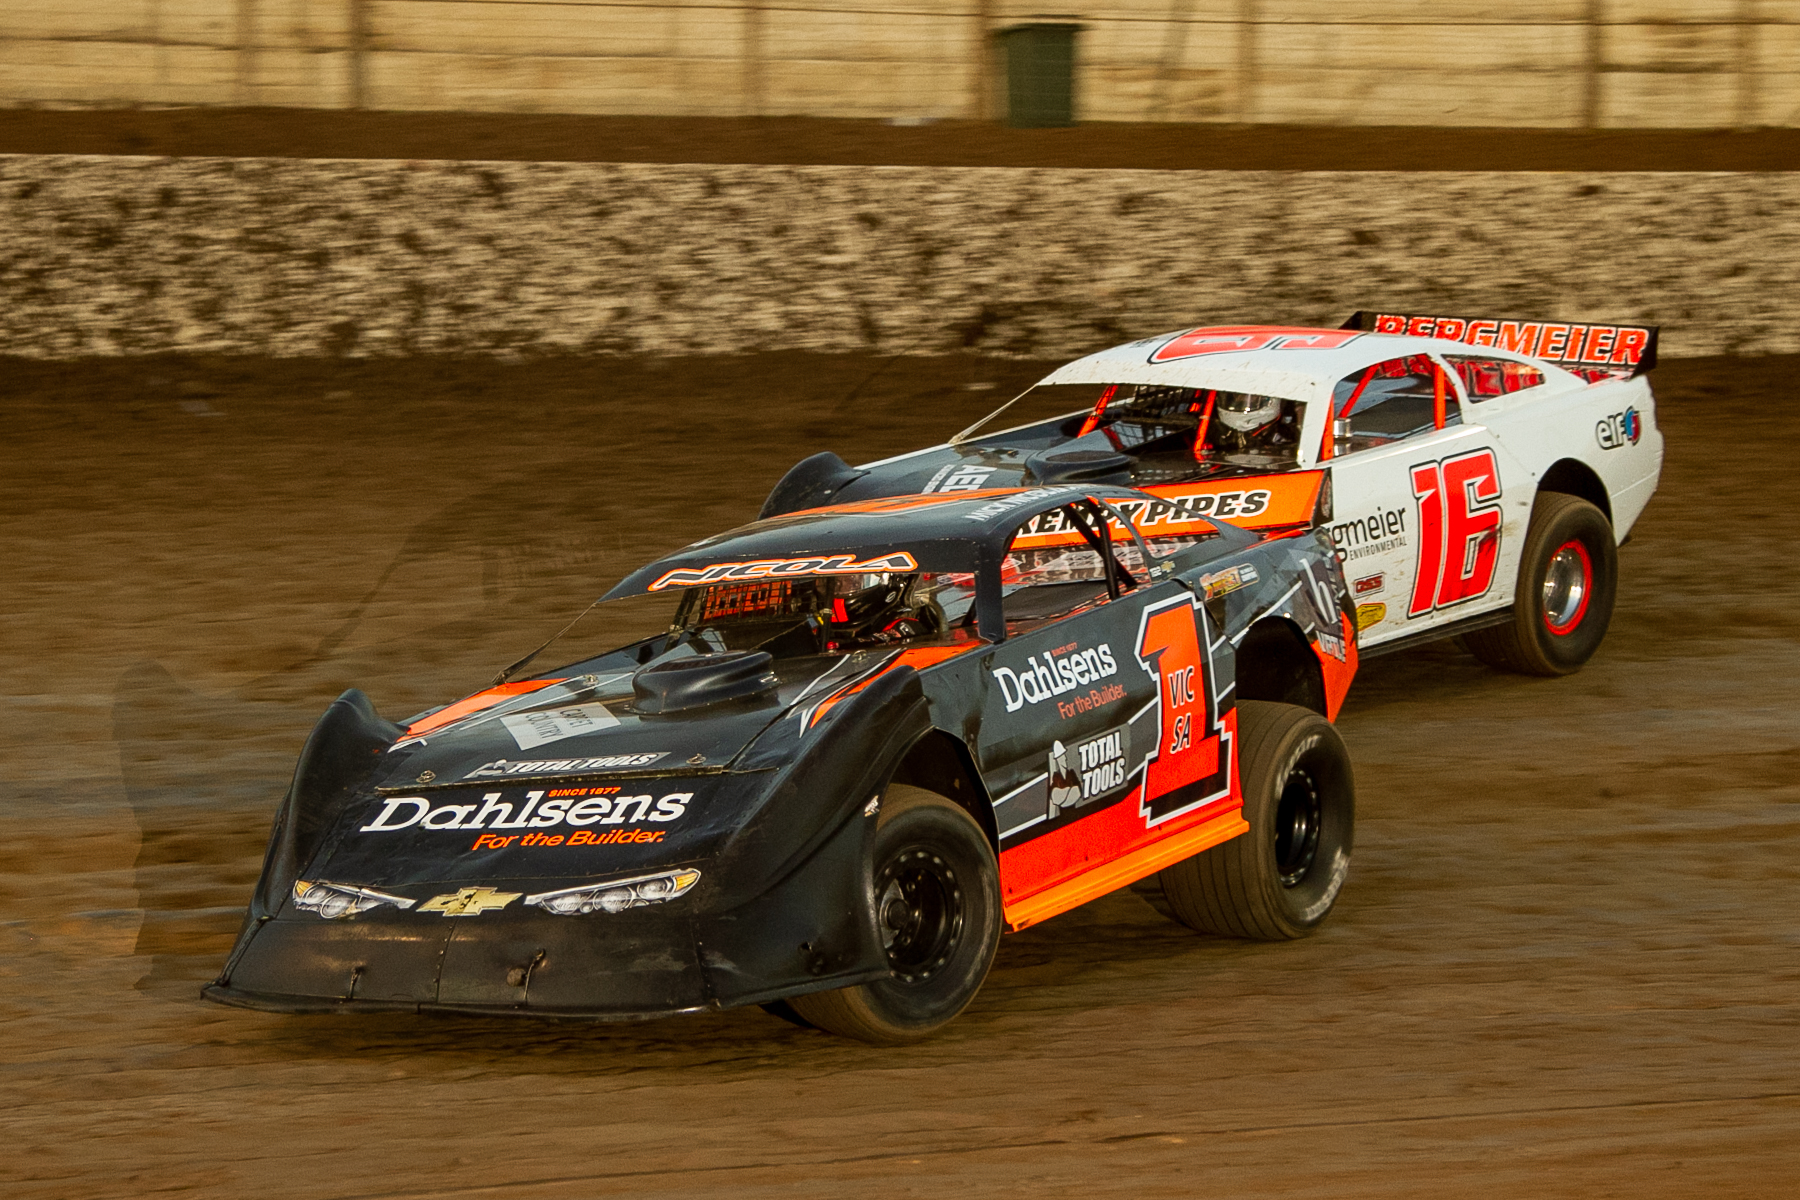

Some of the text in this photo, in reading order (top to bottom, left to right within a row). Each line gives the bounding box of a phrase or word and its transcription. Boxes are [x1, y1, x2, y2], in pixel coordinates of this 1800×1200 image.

[1375, 314, 1649, 366] BERGMEIER
[1141, 489, 1271, 526] PIPES
[1327, 506, 1406, 562] gmeier
[1349, 537, 1407, 561] ENVIRONMENTAL
[1407, 446, 1503, 619] 16
[647, 552, 918, 591] NICOLA
[992, 643, 1117, 713] Dahlsens
[1168, 665, 1195, 709] VIC
[1057, 701, 1076, 720] For
[1074, 695, 1092, 713] the
[1135, 591, 1232, 828] 1
[1078, 731, 1122, 772] TOTAL
[1170, 712, 1192, 755] SA
[507, 753, 658, 774] TOTAL TOOLS
[1082, 757, 1126, 800] TOOLS
[360, 791, 694, 832] Dahlsens
[548, 786, 622, 798] SINCE 1877
[472, 834, 520, 851] For
[520, 831, 564, 848] the
